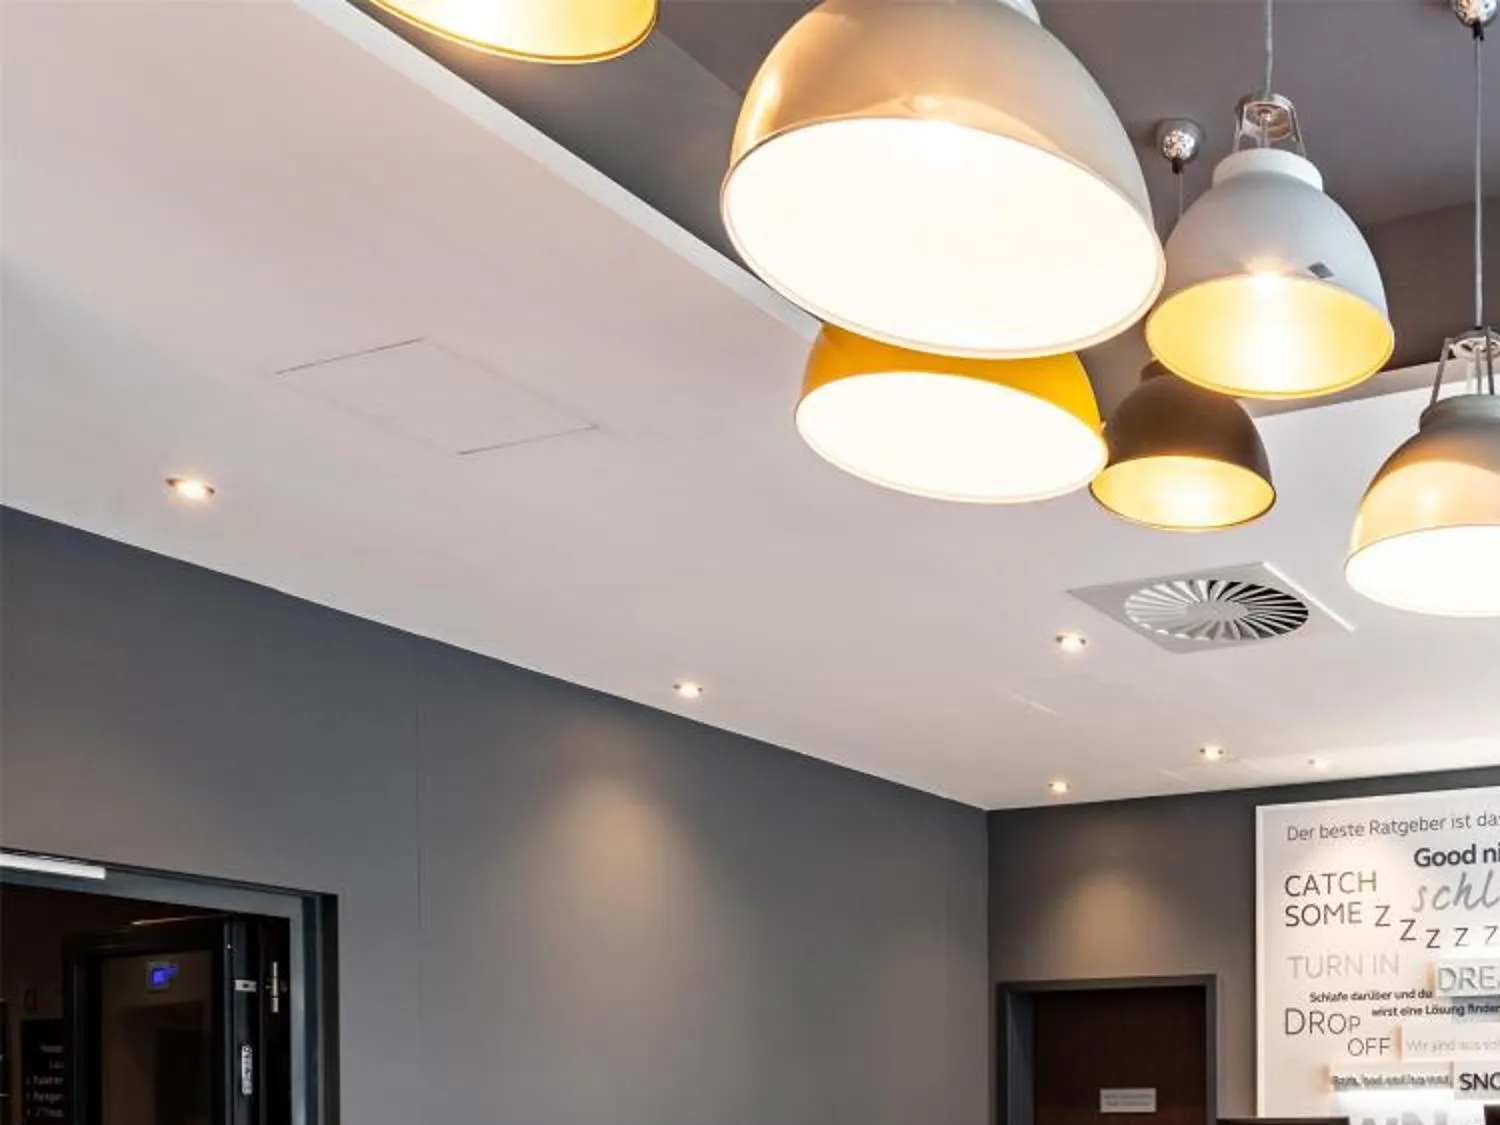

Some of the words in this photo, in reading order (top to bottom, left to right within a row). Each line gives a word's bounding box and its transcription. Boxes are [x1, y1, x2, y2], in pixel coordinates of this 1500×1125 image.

[1287, 825, 1315, 841] Der
[1319, 823, 1365, 838] beste
[1369, 815, 1446, 837] Ratgeber
[1451, 815, 1472, 829] ist
[1413, 844, 1476, 867] Good
[1284, 871, 1377, 897] CATCH
[1285, 902, 1362, 927] SOME
[1287, 954, 1363, 979] TURN
[1285, 1008, 1361, 1035] DROP
[1348, 1038, 1390, 1056] OFF
